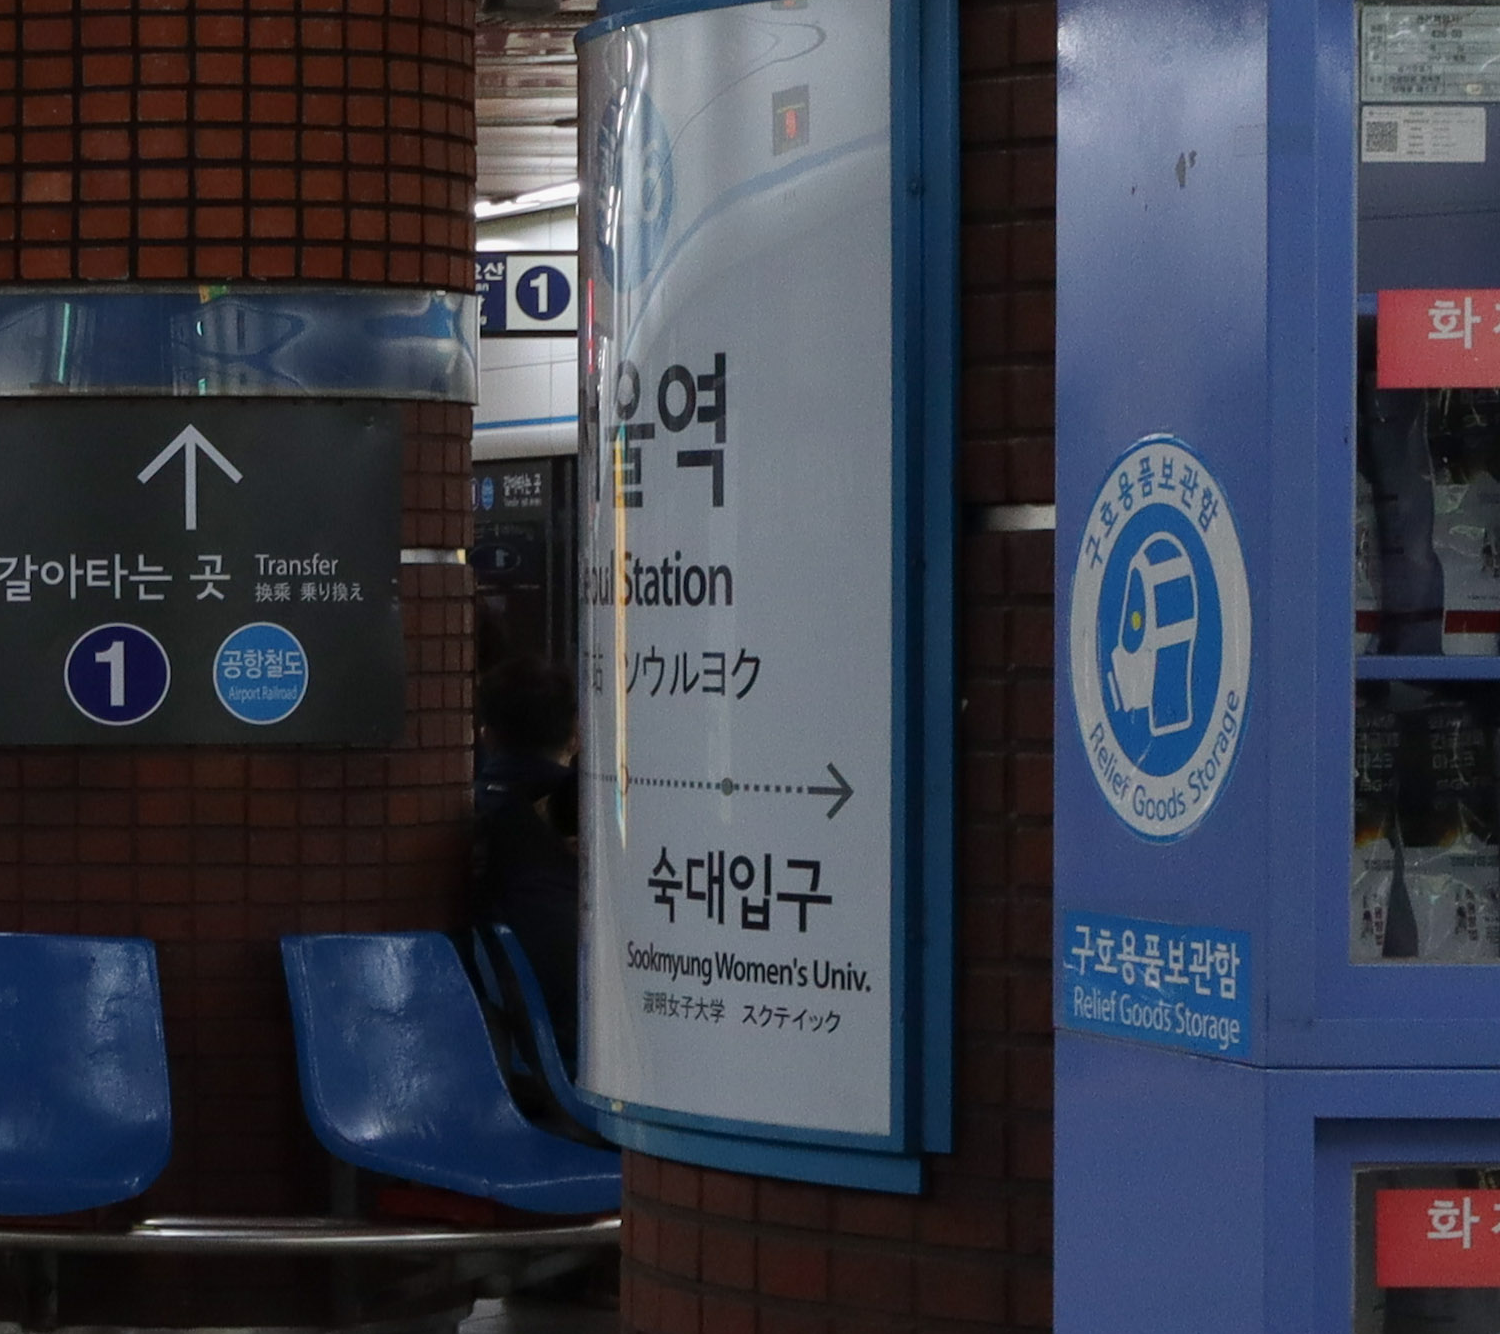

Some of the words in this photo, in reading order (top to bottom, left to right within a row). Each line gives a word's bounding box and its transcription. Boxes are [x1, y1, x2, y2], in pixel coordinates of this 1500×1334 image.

[529, 272, 548, 314] 1
[1084, 454, 1220, 573] 구호용품보관함
[189, 554, 231, 602] 곳
[255, 554, 339, 577] Transfer
[620, 550, 733, 607] Station
[94, 640, 126, 708] 1
[222, 648, 303, 680] 공항철도
[623, 644, 762, 701] ソウルヨク
[228, 684, 260, 704] Airport
[262, 684, 298, 702] Railroad
[1089, 721, 1132, 805] Relief
[1132, 776, 1187, 822] Goods
[1189, 687, 1241, 804] Storage
[647, 845, 833, 934] 숙대입구
[626, 939, 713, 987] Sookmyung
[714, 951, 809, 988] Women's
[812, 959, 872, 994] Univ.
[1071, 924, 1242, 1001] 구호용품보관함
[1073, 984, 1118, 1023] Relief
[1119, 992, 1172, 1033] Goods
[1174, 1001, 1242, 1051] Storage
